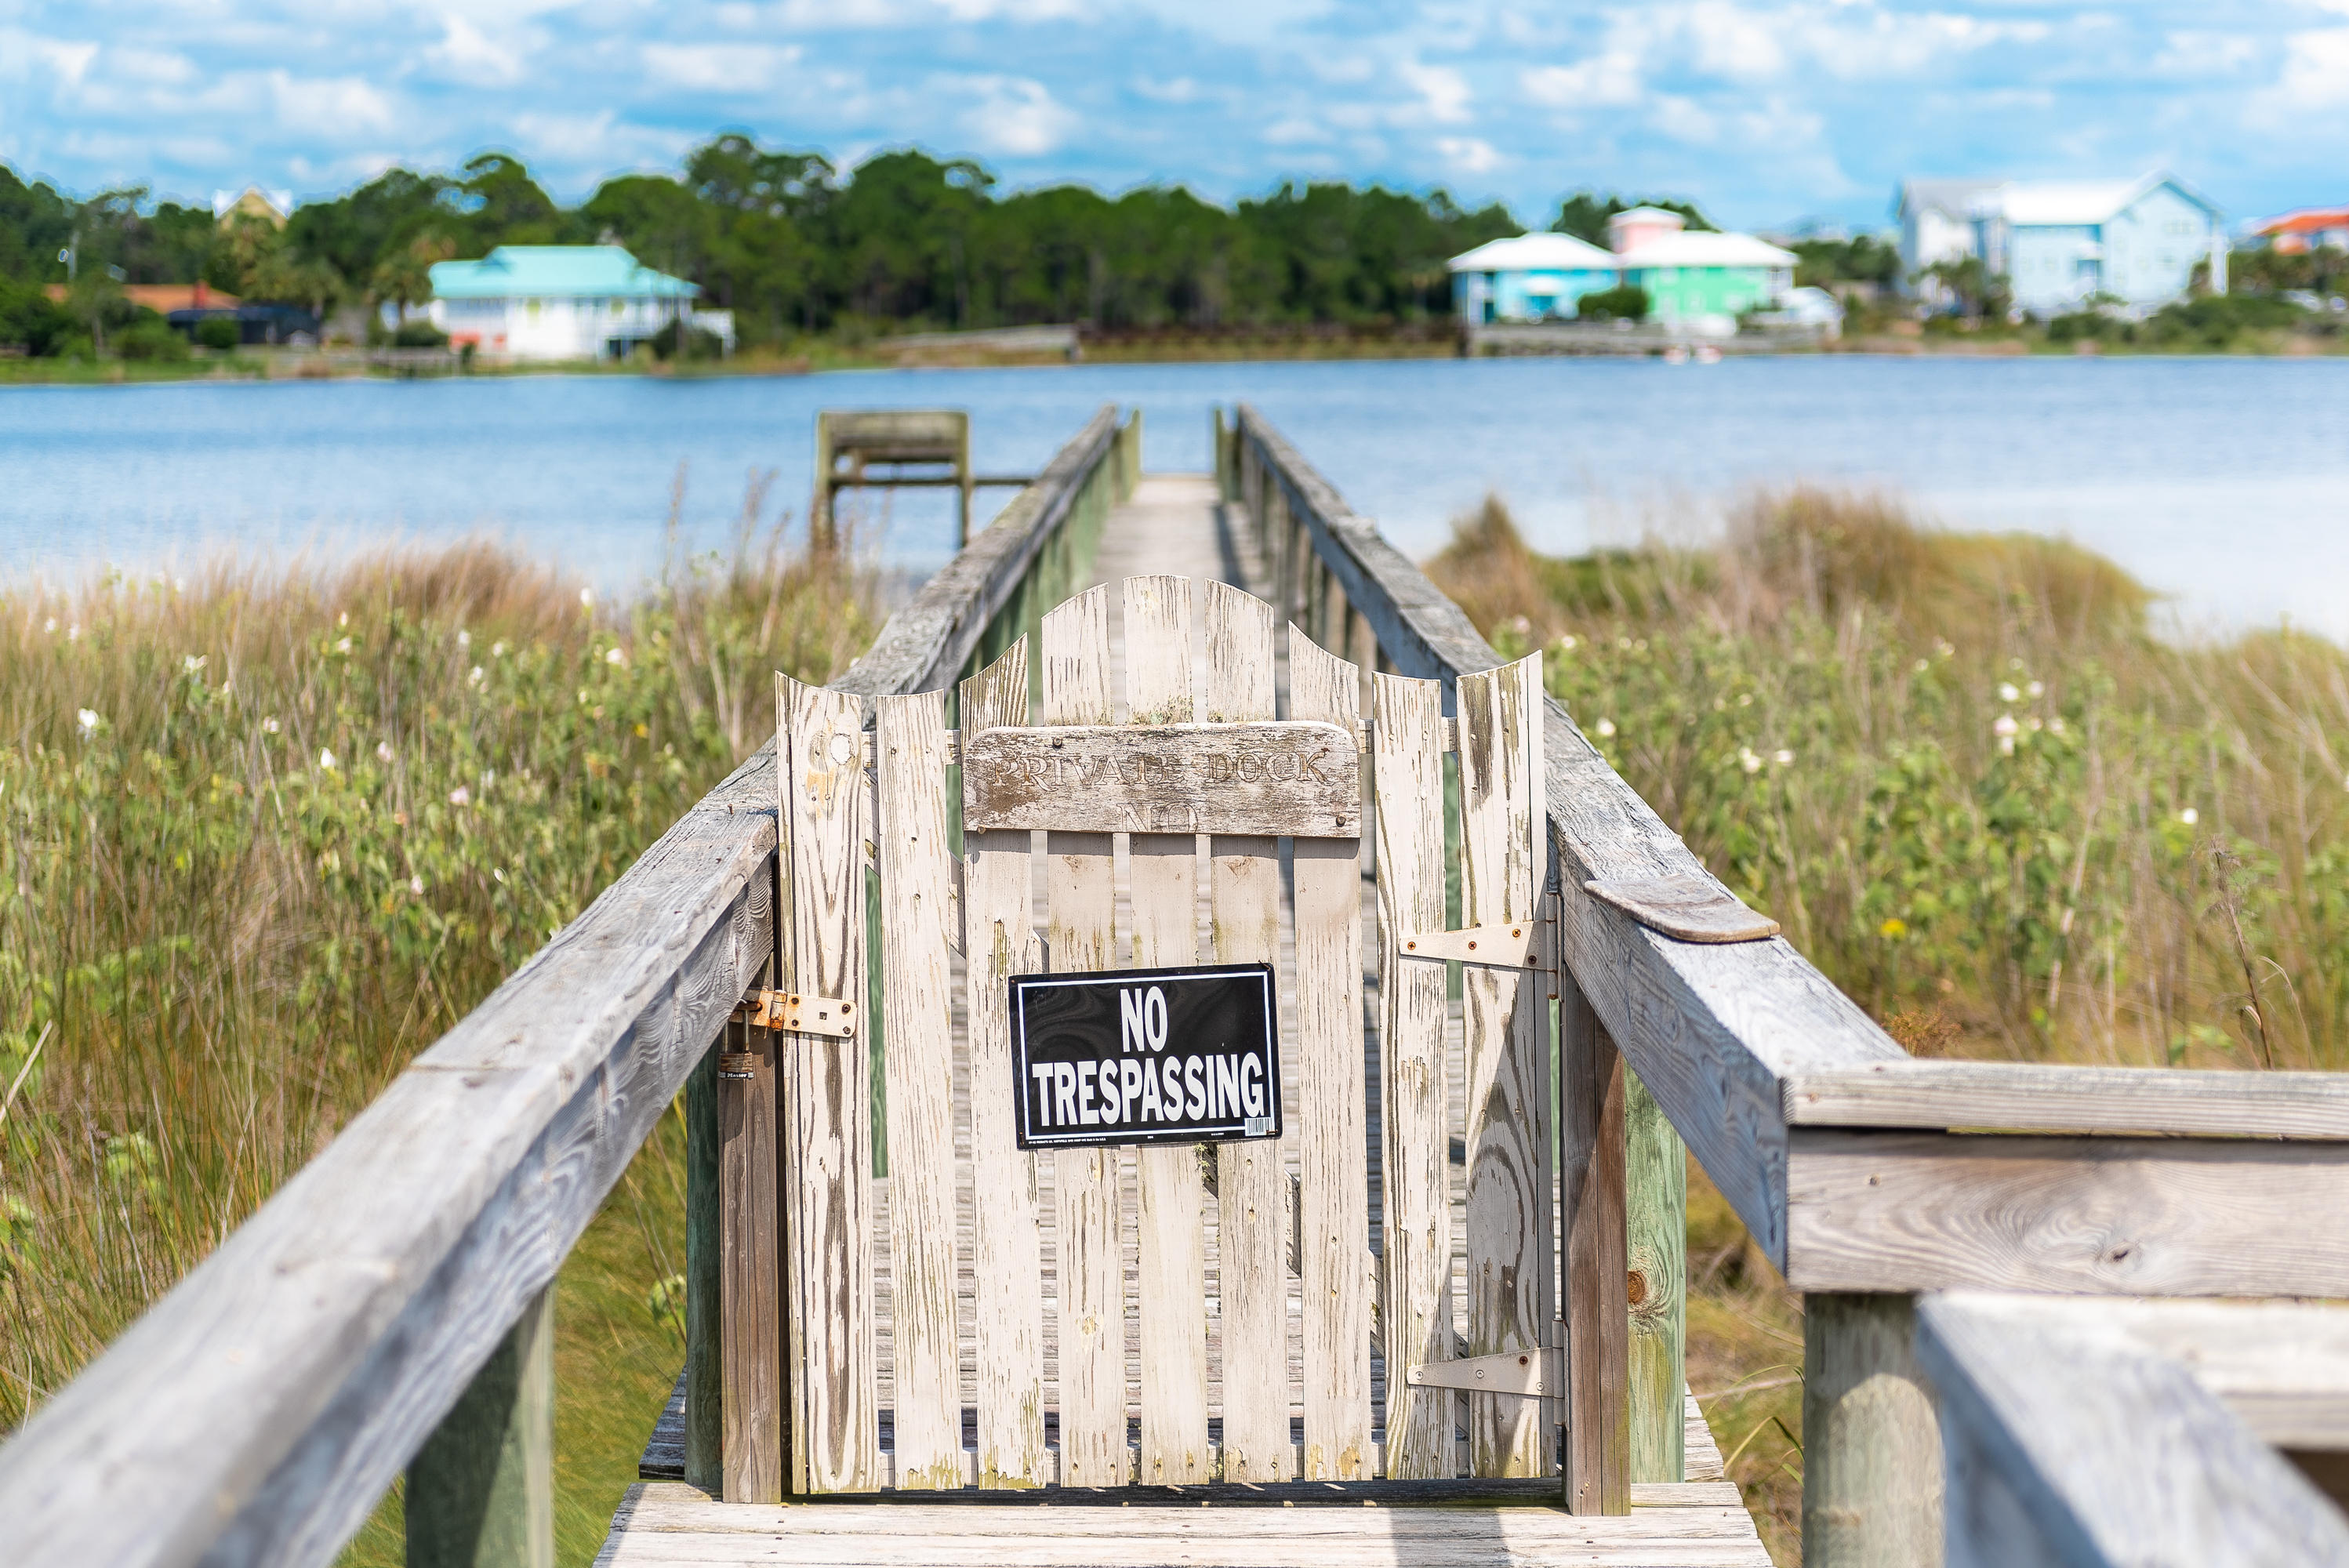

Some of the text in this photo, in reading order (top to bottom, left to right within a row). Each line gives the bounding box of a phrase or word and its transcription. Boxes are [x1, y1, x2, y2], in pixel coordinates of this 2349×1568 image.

[989, 750, 1335, 792] PRIVATE DOCK
[1116, 801, 1199, 832] NO
[1120, 985, 1168, 1052] NO
[1032, 1052, 1265, 1127] TRESPASSING
